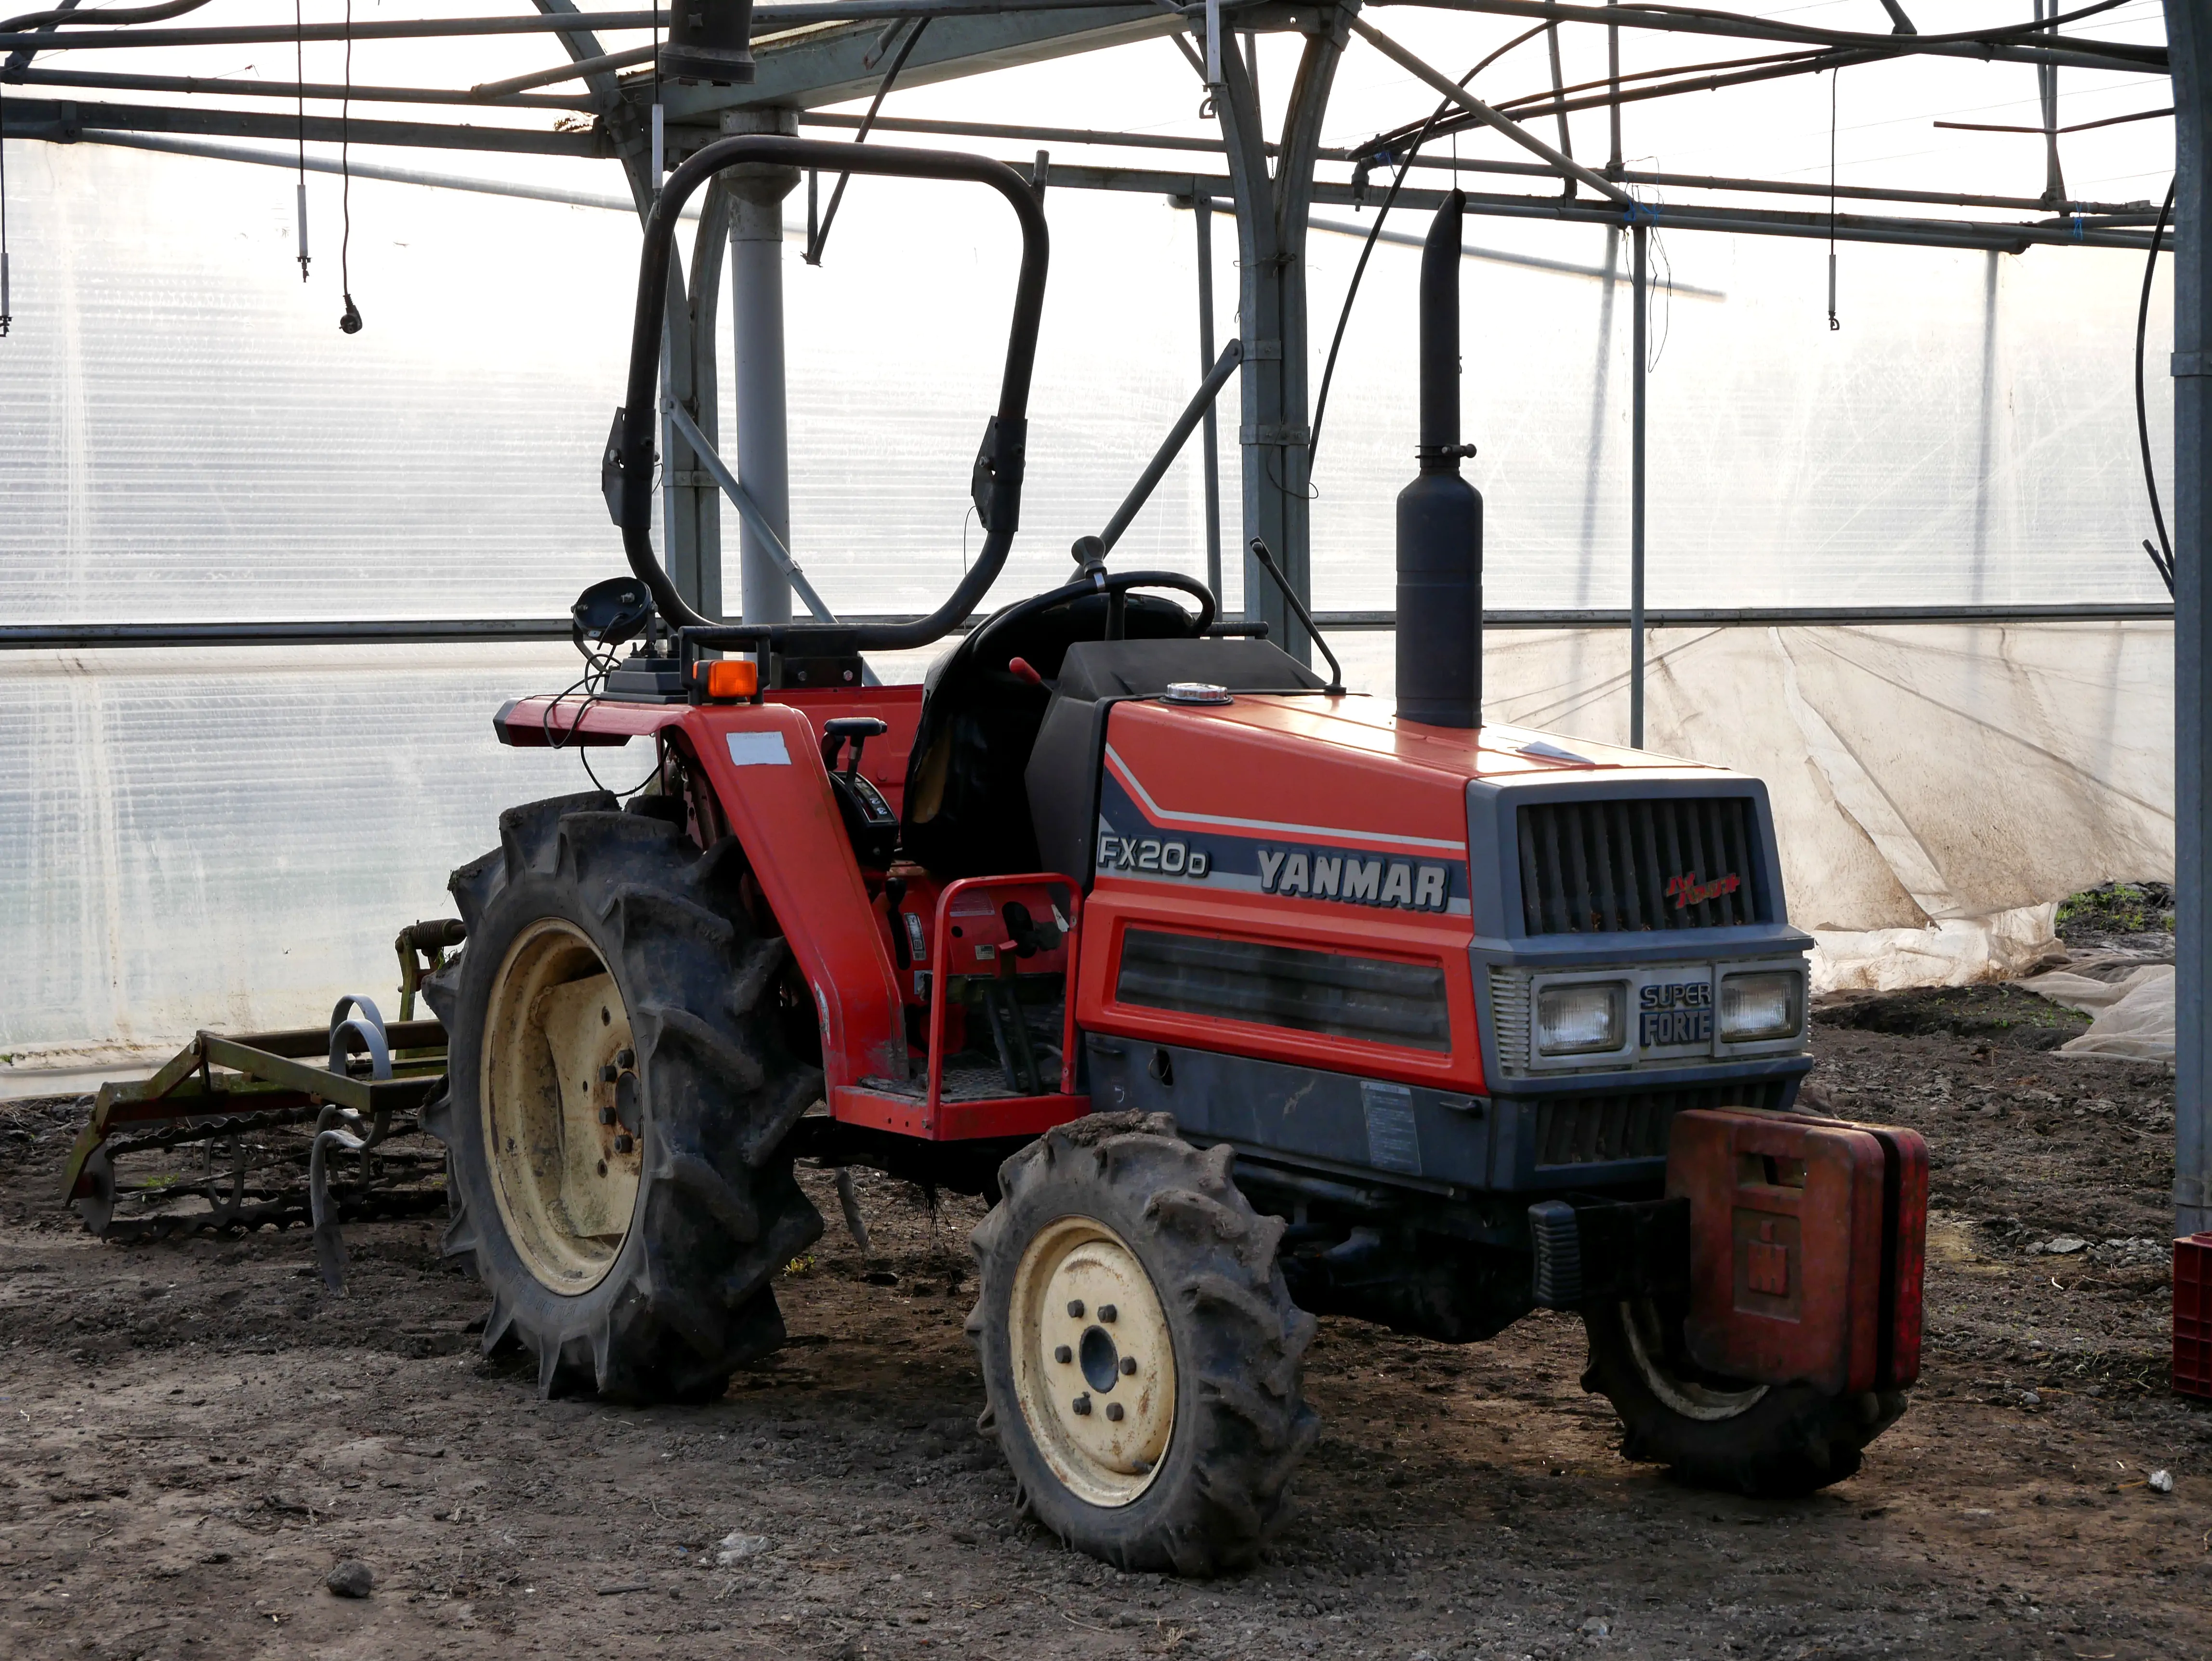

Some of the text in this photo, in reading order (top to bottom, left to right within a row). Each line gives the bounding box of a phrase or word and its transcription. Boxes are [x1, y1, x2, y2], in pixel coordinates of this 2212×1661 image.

[1257, 848, 1447, 910] YANMAR
[1641, 982, 1711, 1009] SUPER
[1640, 1009, 1711, 1046] FORTE
